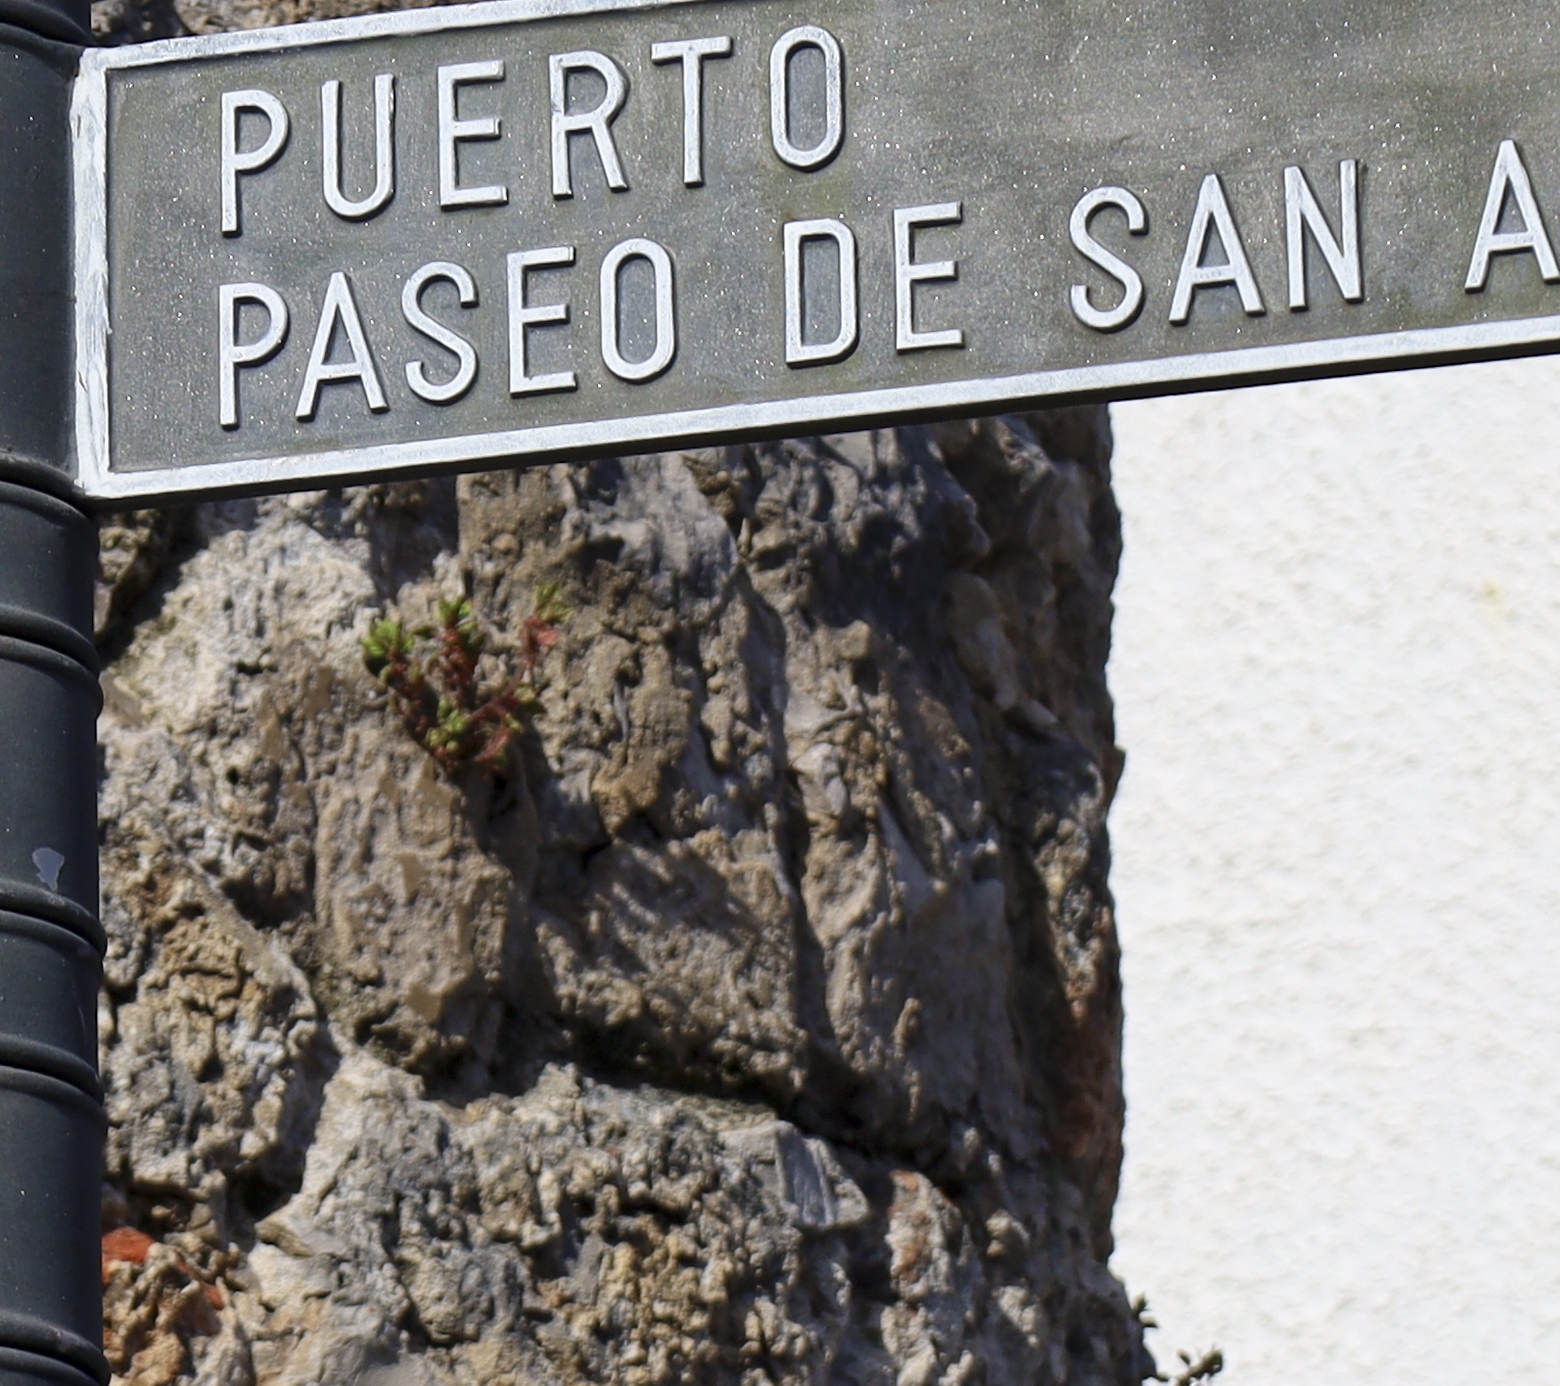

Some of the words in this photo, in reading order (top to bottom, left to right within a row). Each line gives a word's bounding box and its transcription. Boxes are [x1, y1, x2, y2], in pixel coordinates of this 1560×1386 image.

[219, 23, 842, 232] PUERTO
[217, 236, 675, 426] PASEO
[783, 200, 963, 363] DE
[1068, 158, 1364, 328] SAN
